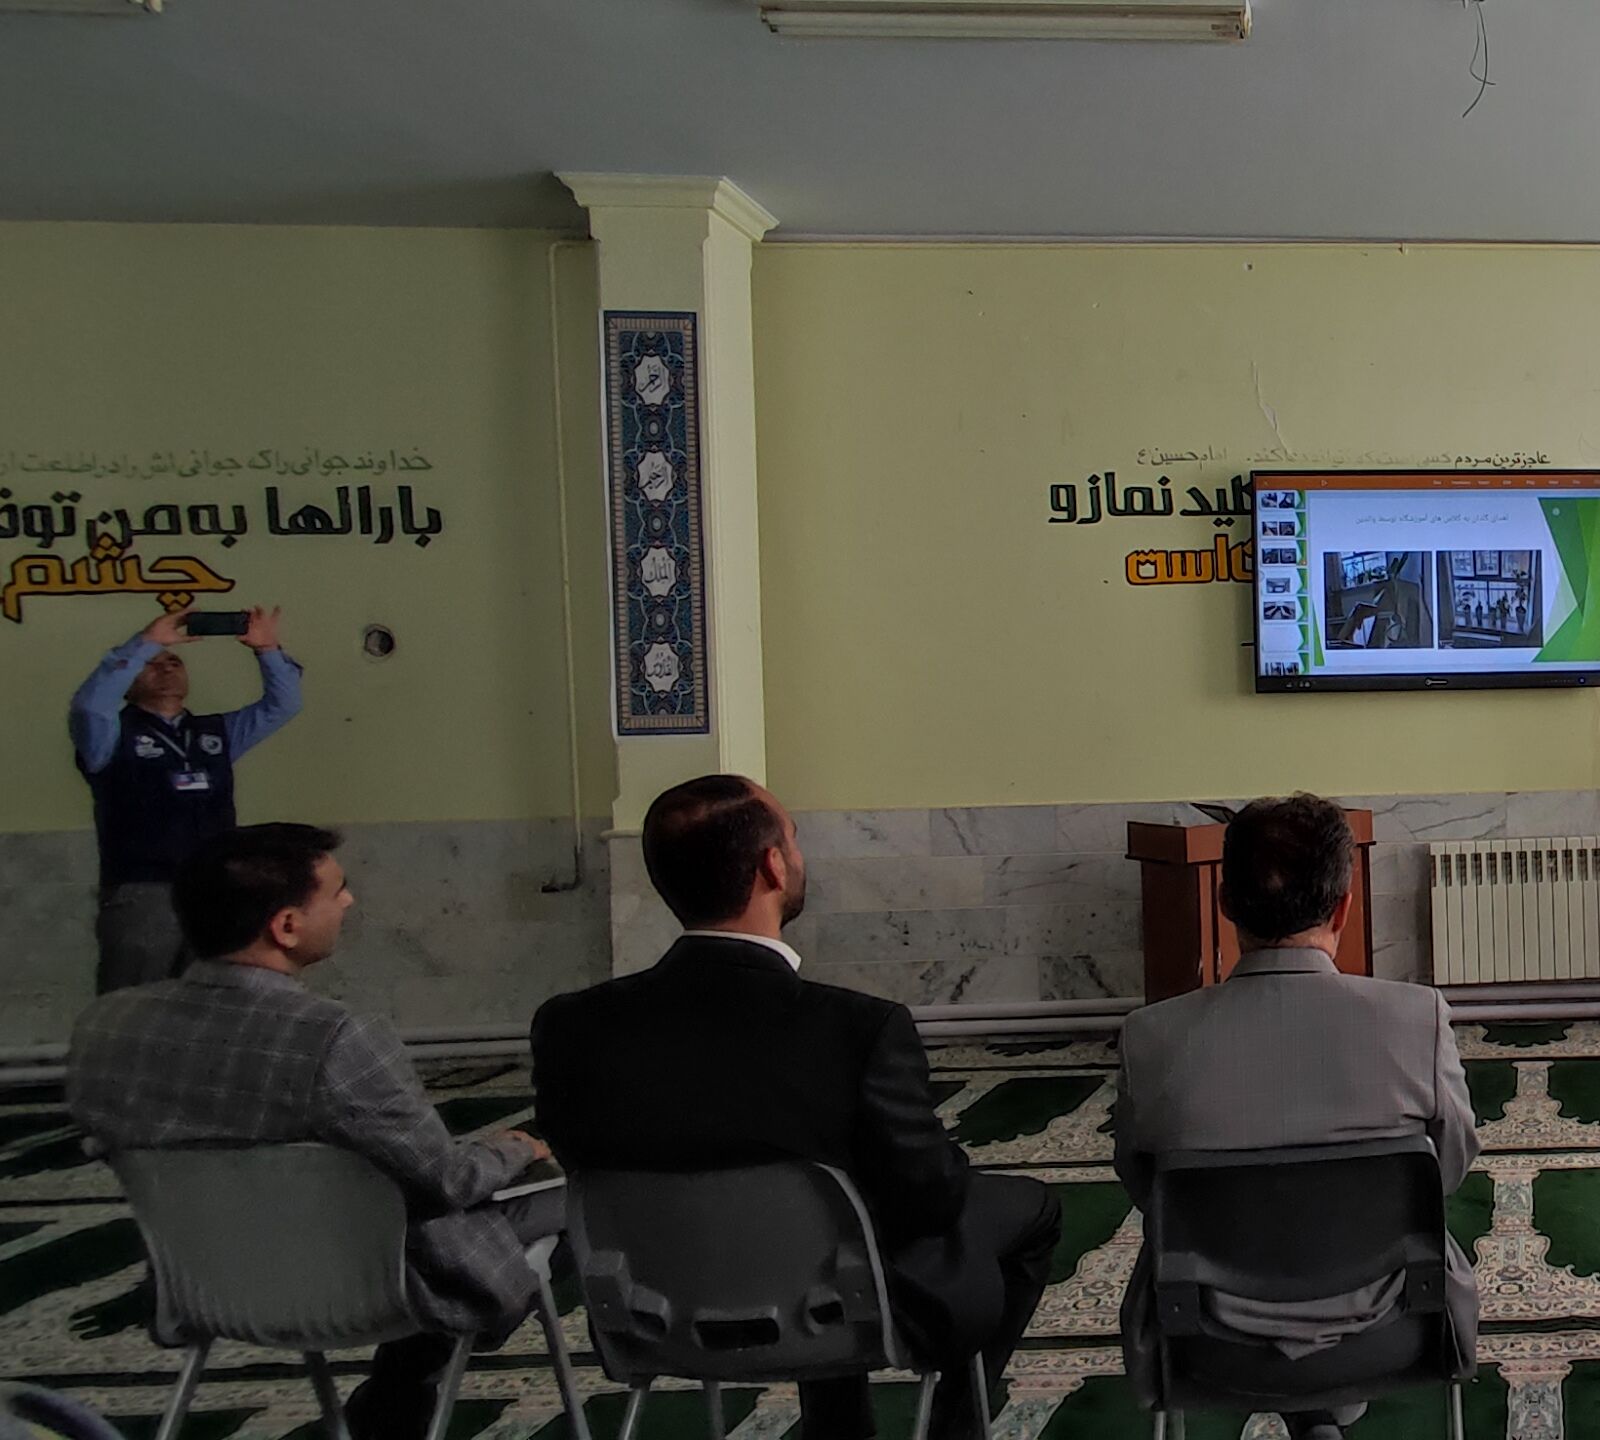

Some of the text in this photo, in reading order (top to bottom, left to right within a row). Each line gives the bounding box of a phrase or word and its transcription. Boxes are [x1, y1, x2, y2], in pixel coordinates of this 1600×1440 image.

[1048, 484, 1078, 523] و
[1076, 471, 1175, 524] نماز
[86, 504, 182, 550] من
[187, 504, 248, 548] به
[3, 532, 236, 623] چشم
[1125, 533, 1231, 586] است
